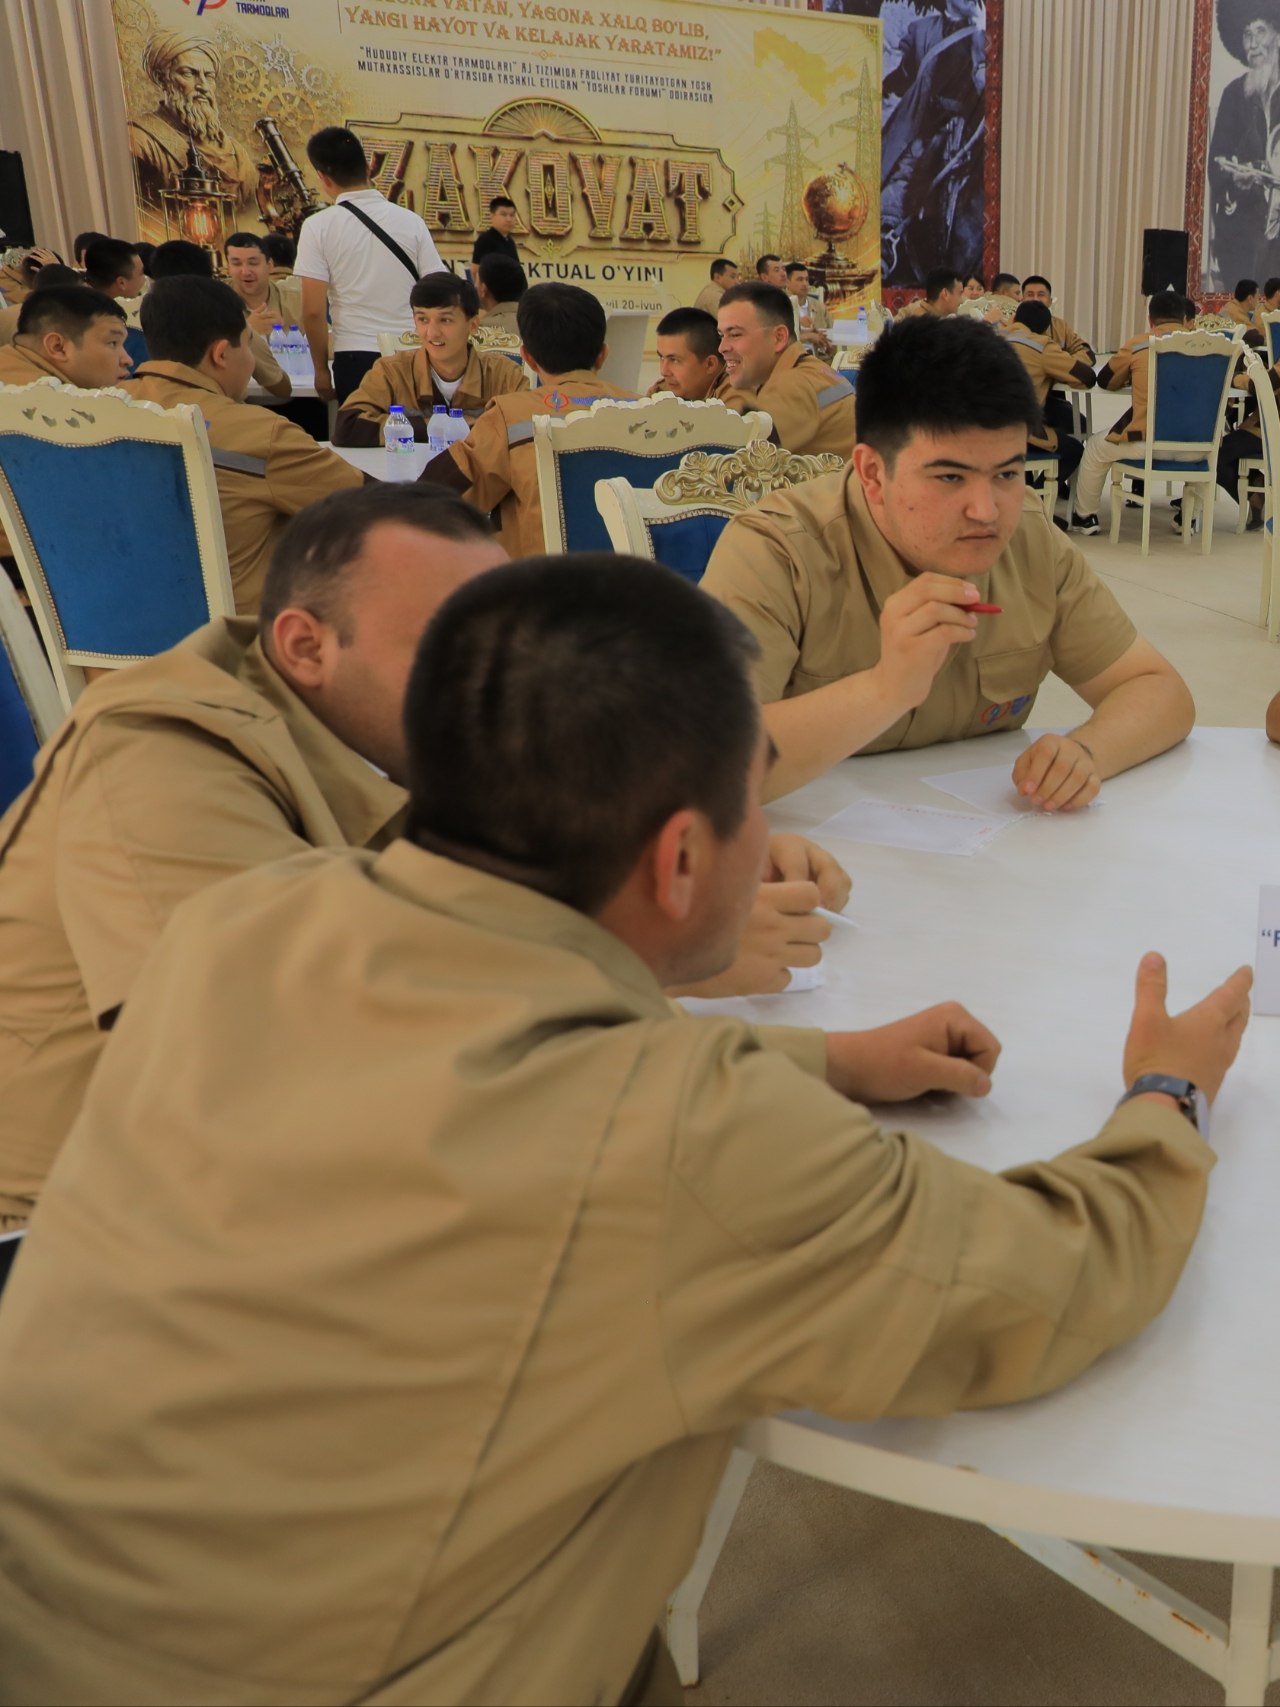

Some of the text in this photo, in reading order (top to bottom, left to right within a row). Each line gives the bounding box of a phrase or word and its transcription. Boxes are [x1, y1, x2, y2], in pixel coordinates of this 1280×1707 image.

[236, 2, 290, 19] TARMOQLARI
[345, 5, 408, 29] YANGI
[413, 14, 478, 37] HAYOT
[483, 21, 511, 41] VA
[515, 26, 601, 50] KELAJAK
[518, 3, 595, 26] YAGONA
[599, 12, 648, 33] XALQ
[357, 60, 441, 78] MUTAXASSISLAR
[498, 73, 537, 88] TASHKIL
[540, 77, 579, 91] ETILGAN
[669, 90, 714, 104] DOIRASIDA
[412, 52, 449, 66] ELEKTR
[521, 65, 532, 75] AJ
[536, 65, 577, 79] TIZIMIDA
[580, 69, 621, 83] FAOLIYAT
[691, 79, 712, 91] YOSH
